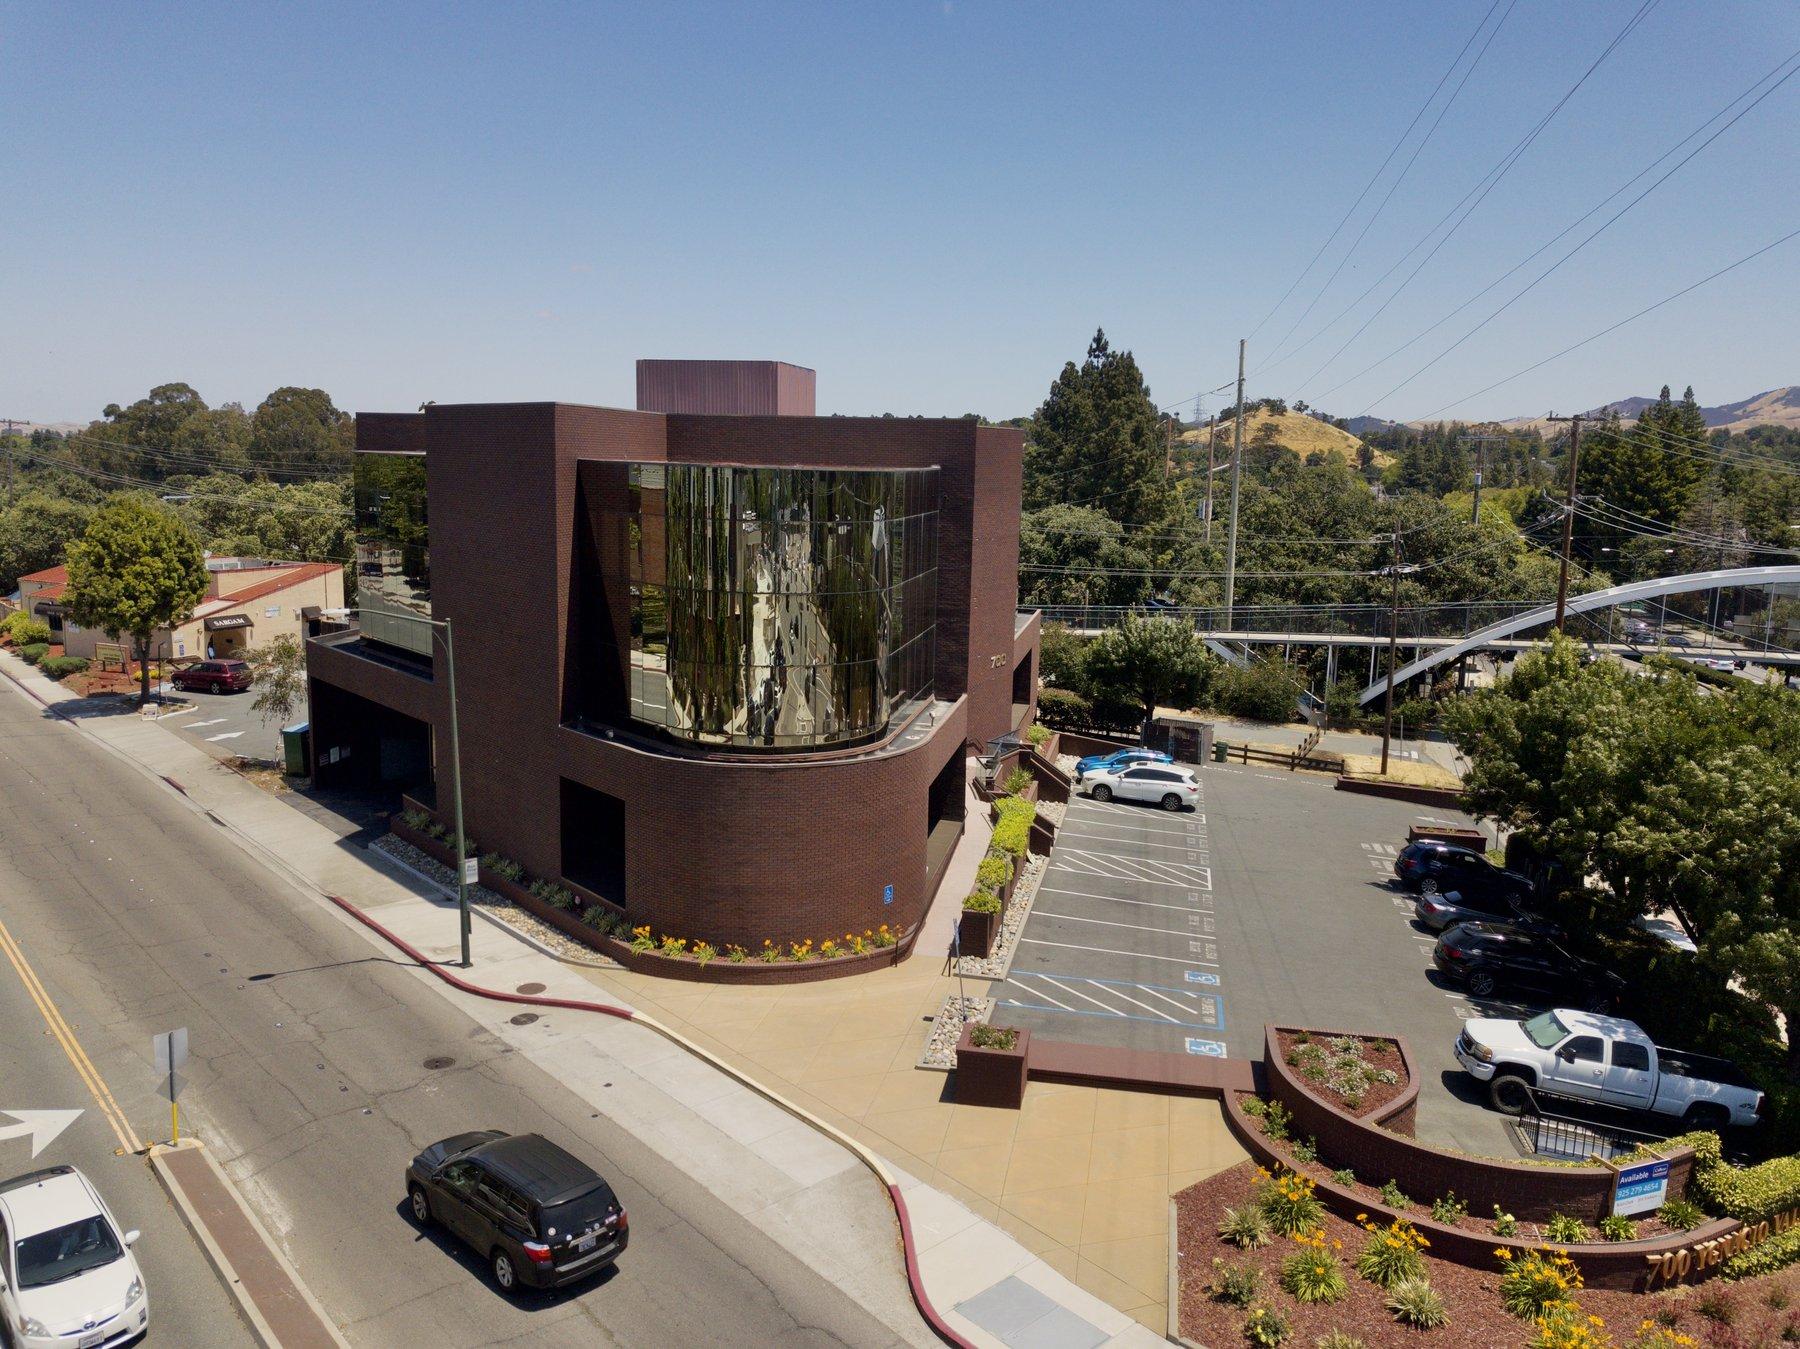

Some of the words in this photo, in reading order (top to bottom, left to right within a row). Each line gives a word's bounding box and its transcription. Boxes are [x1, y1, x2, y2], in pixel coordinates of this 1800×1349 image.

[213, 618, 245, 627] SARGAM
[991, 653, 1006, 668] 700
[1619, 1171, 1649, 1184] Available
[1646, 1248, 1691, 1291] 700
